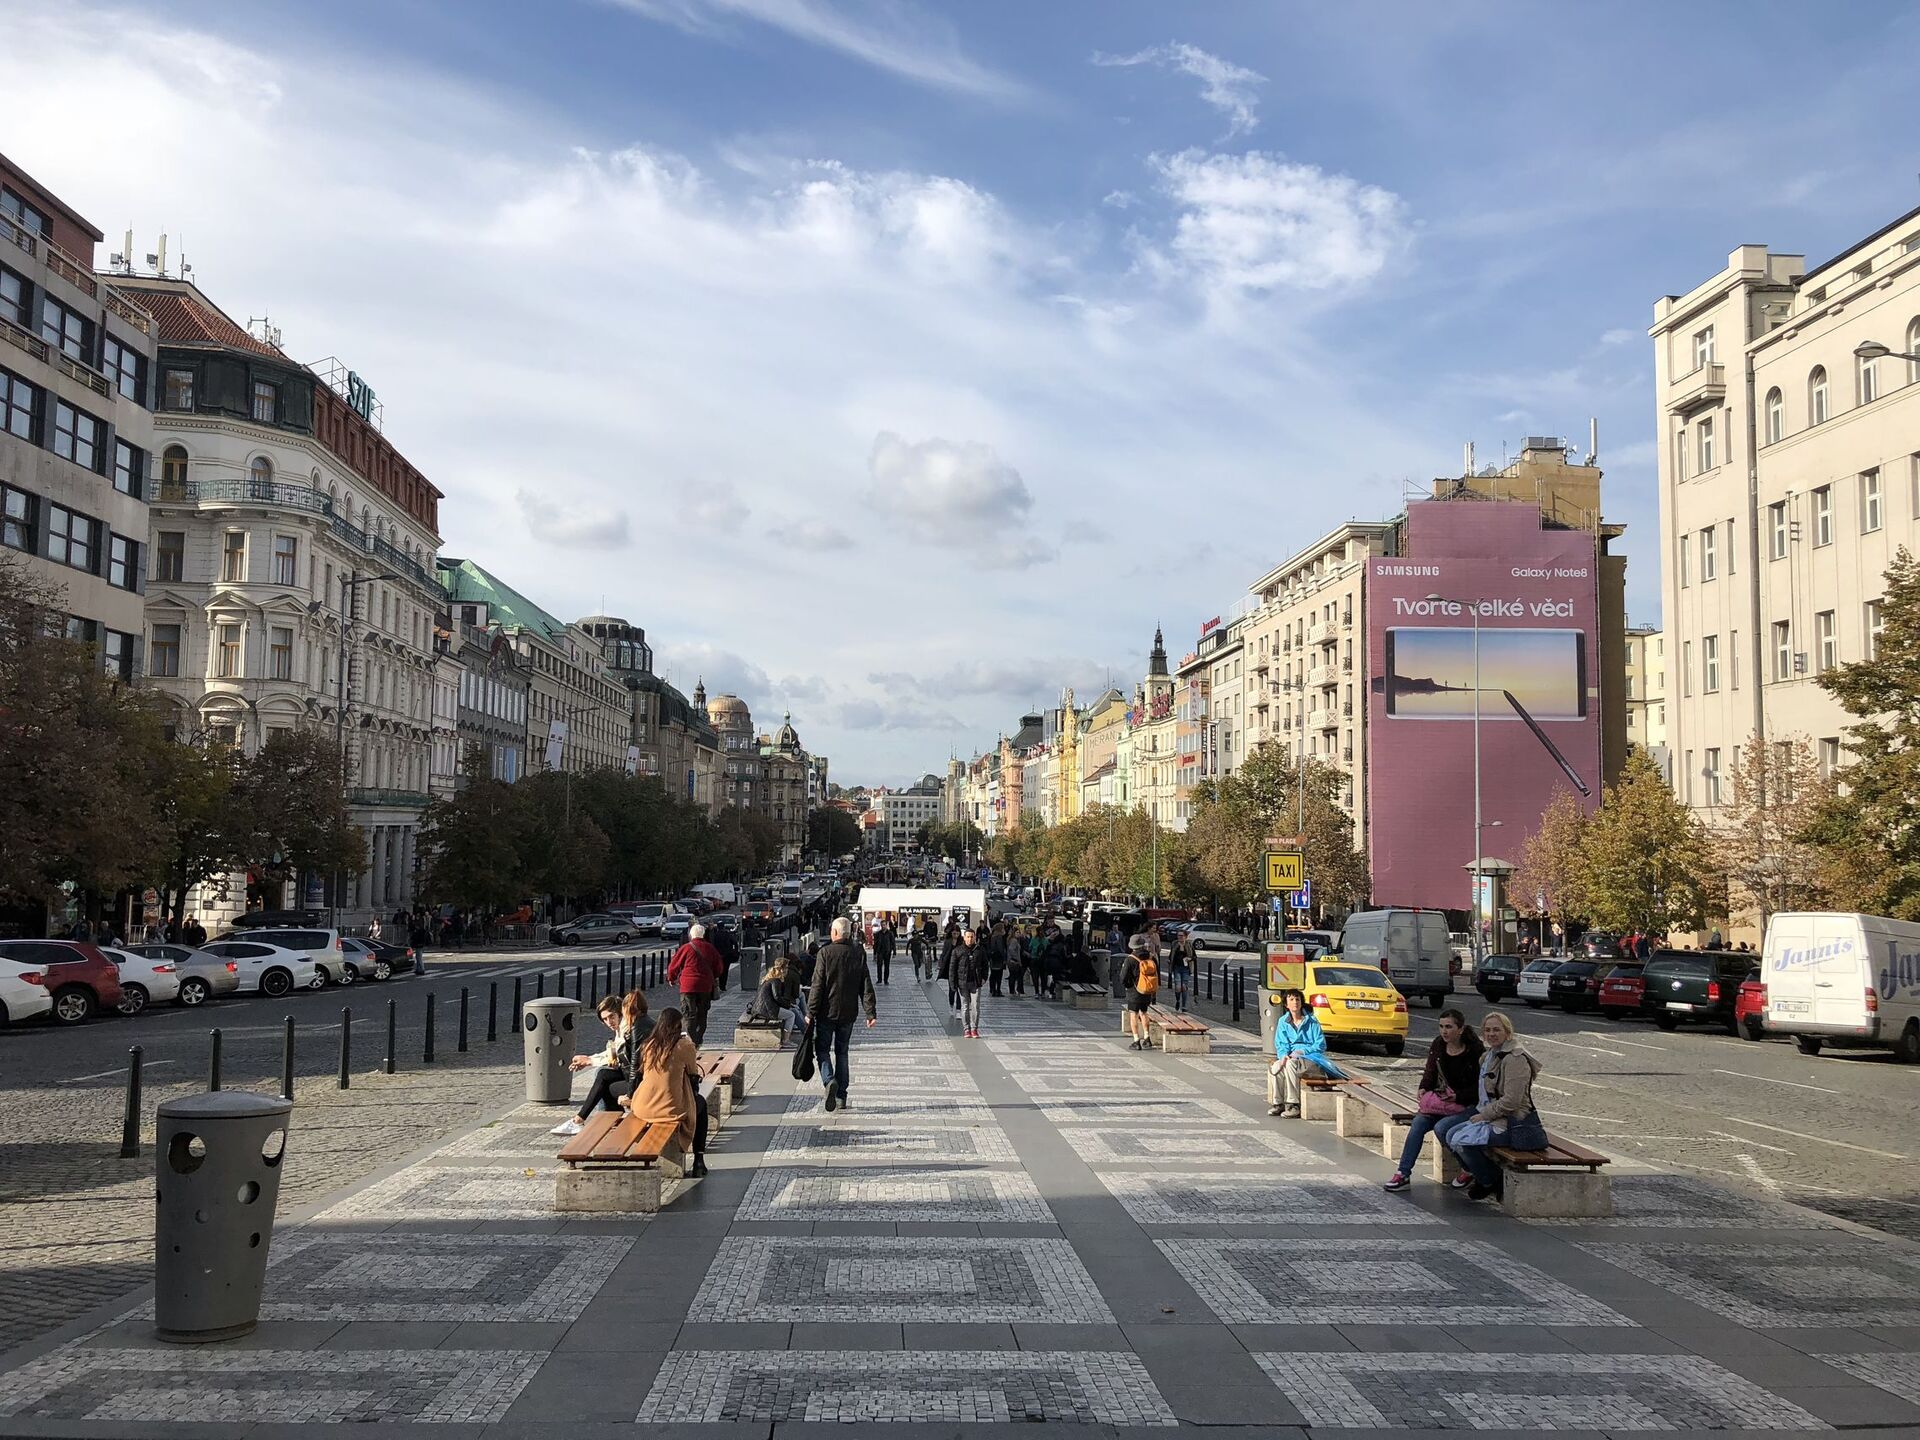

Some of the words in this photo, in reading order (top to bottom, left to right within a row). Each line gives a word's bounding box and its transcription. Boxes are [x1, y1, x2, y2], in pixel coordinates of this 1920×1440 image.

[1376, 565, 1440, 576] SAMSUNG
[1511, 567, 1551, 580] Galaxy
[1554, 567, 1588, 578] Note8
[1530, 598, 1574, 617] věci
[1272, 864, 1296, 878] TAXI
